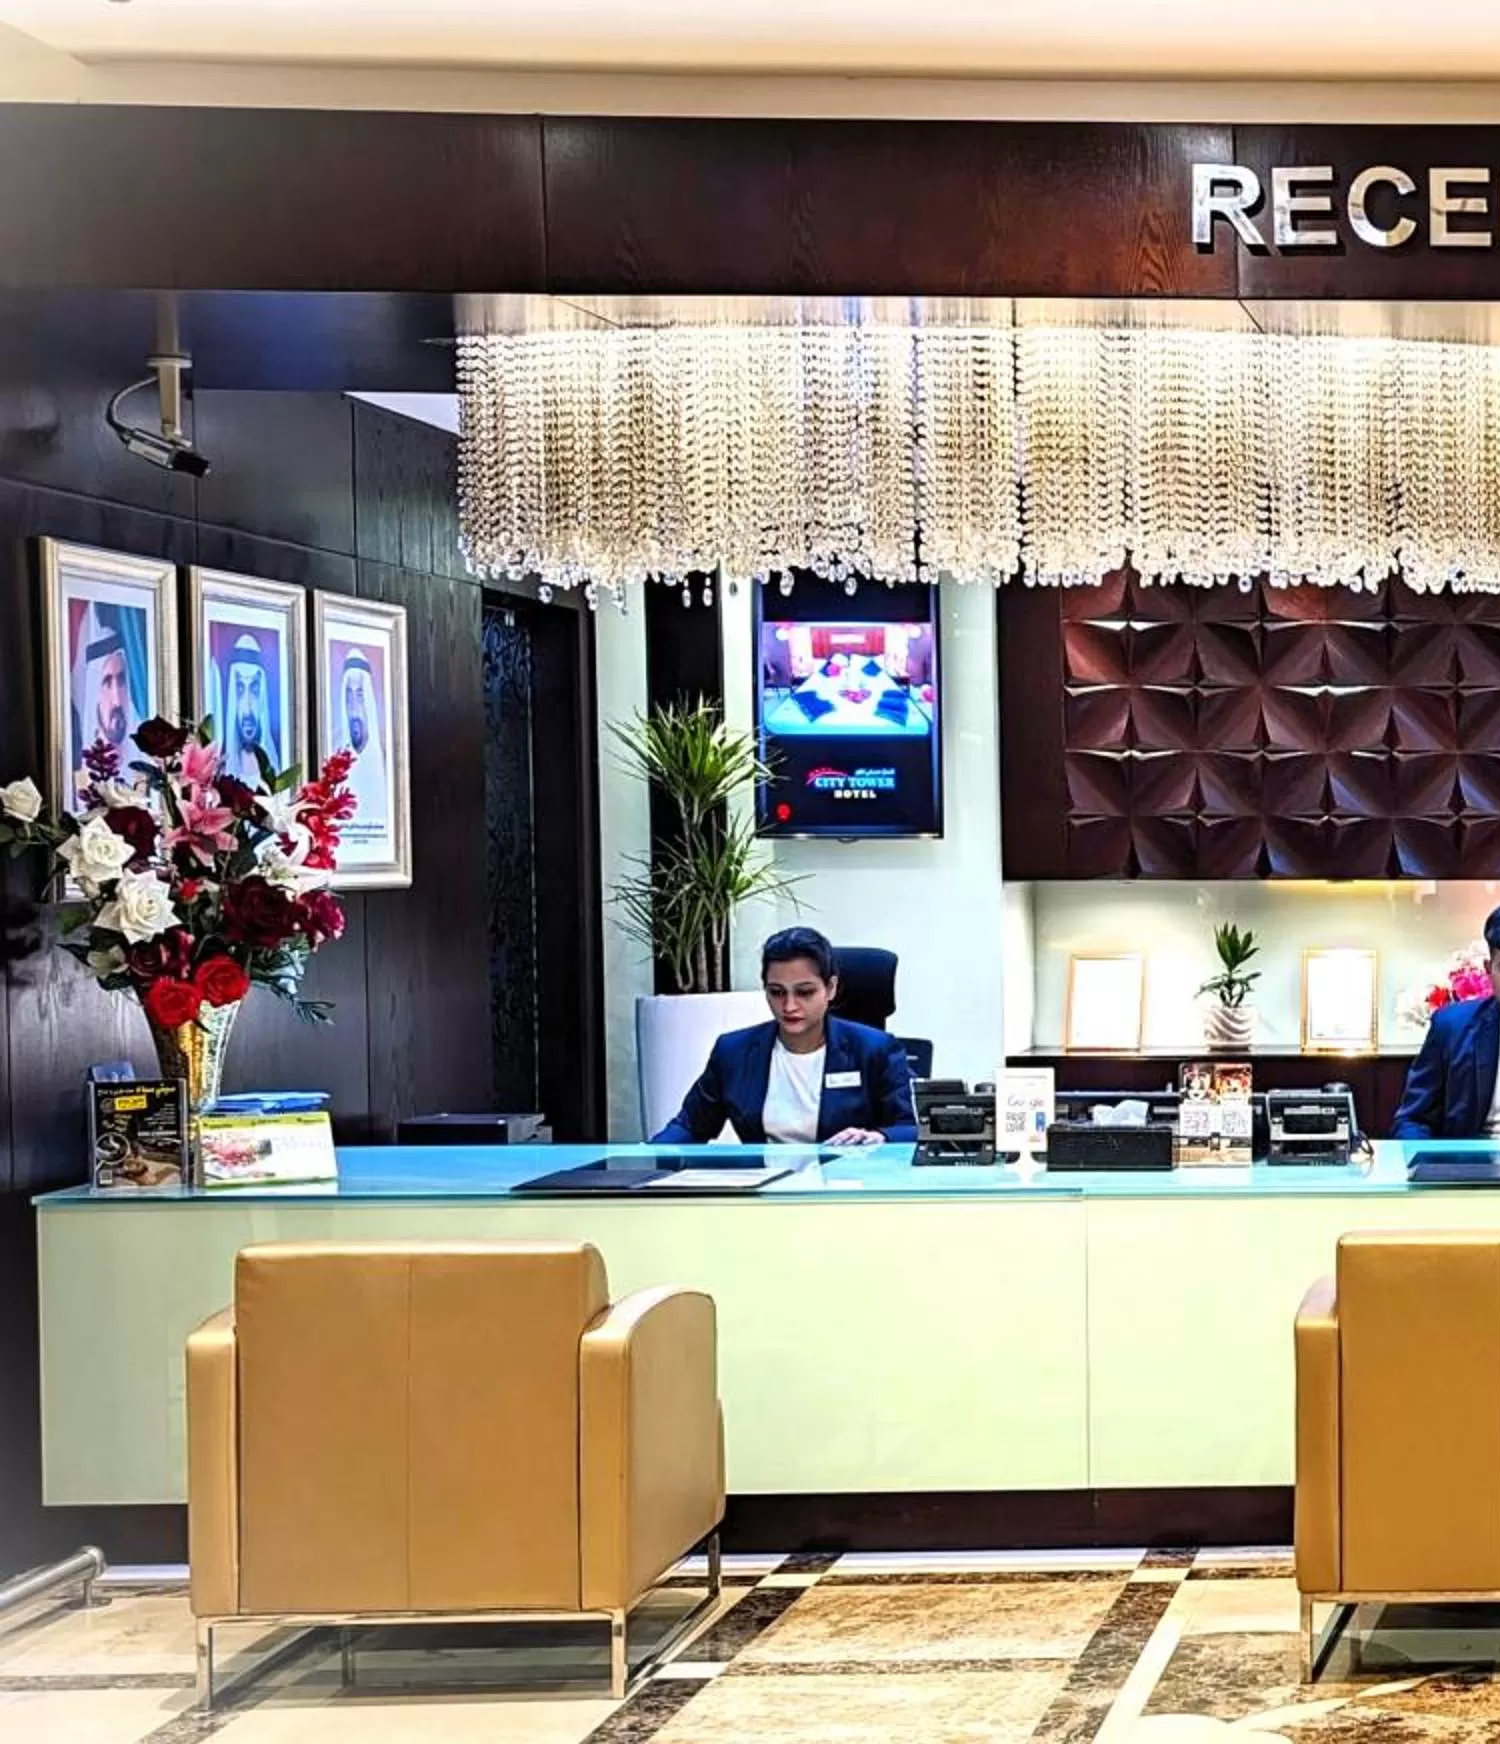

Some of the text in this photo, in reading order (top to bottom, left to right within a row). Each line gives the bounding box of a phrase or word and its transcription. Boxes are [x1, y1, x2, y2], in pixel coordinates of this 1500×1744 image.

[814, 777, 846, 789] CITY
[833, 789, 877, 799] HOTEL
[1007, 1094, 1045, 1110] Gogle
